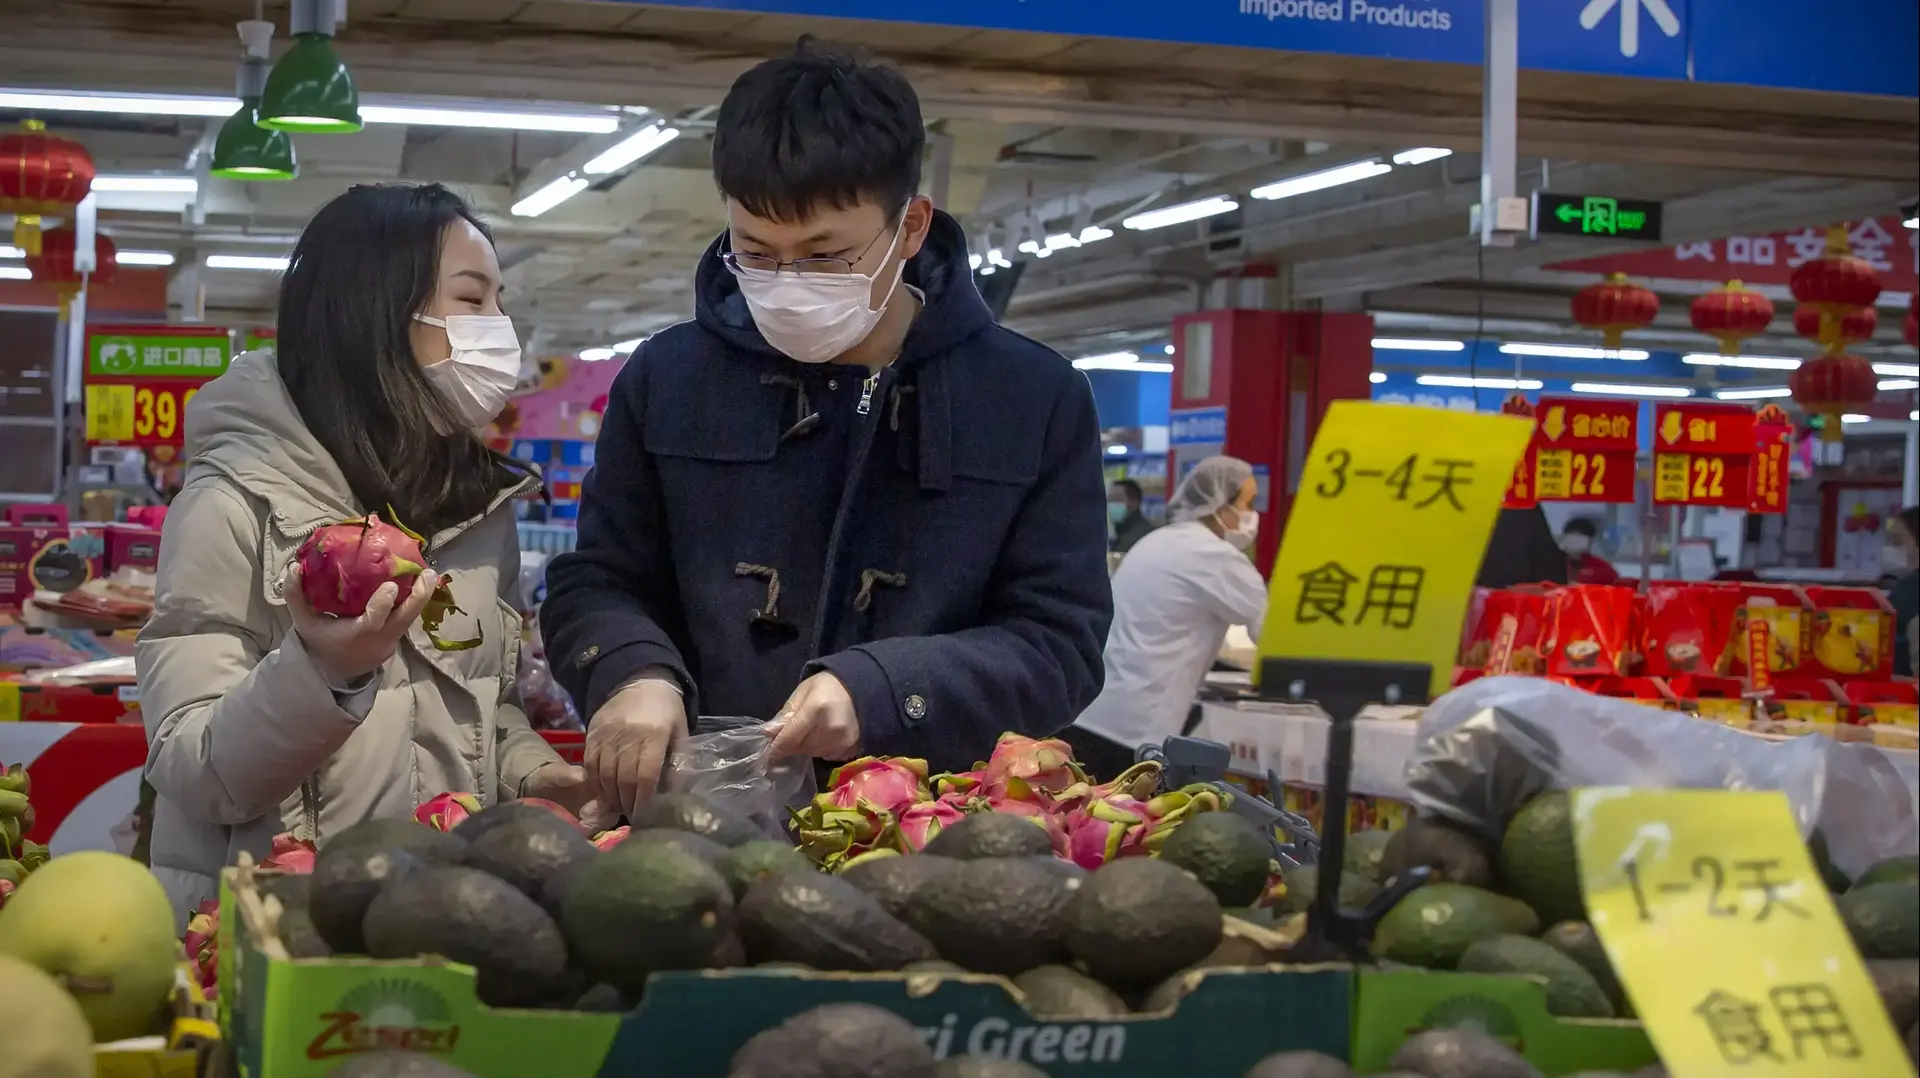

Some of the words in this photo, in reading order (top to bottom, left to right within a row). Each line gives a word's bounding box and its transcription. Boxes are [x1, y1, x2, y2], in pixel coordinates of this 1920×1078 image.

[1239, 0, 1343, 21] Imported
[1350, 4, 1452, 30] Products
[1315, 448, 1475, 512] 3-4天
[1572, 454, 1606, 494] 22
[1692, 457, 1724, 497] 22
[1294, 561, 1425, 628] 食用
[1618, 857, 1811, 923] 1-2天
[967, 1016, 1126, 1063] Green
[1693, 982, 1864, 1064] 食用
